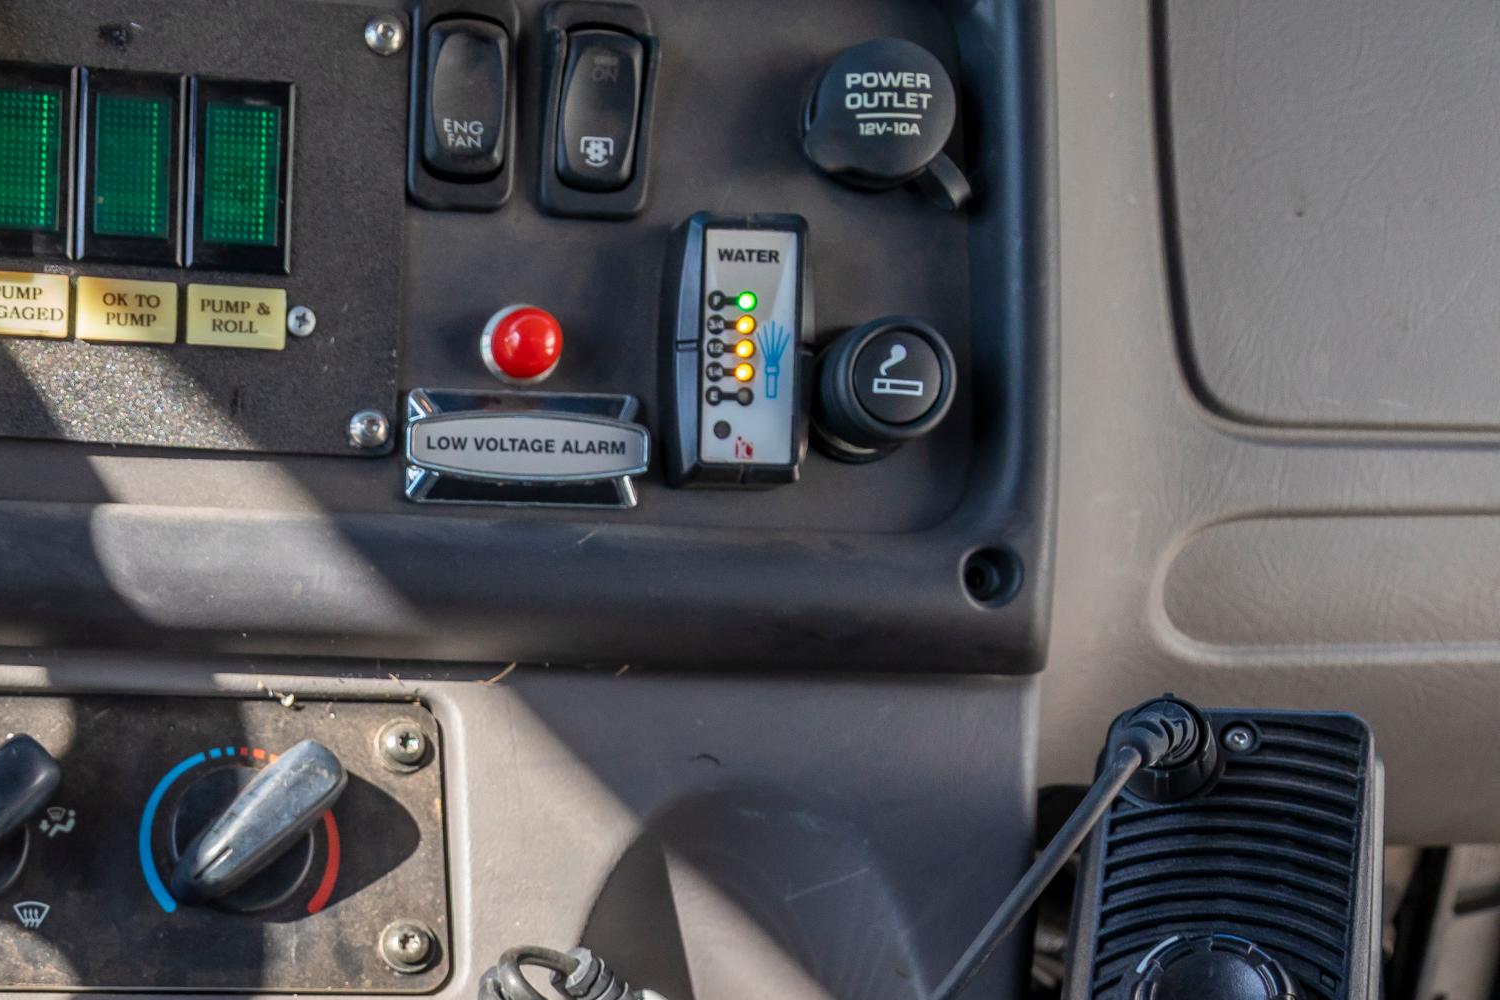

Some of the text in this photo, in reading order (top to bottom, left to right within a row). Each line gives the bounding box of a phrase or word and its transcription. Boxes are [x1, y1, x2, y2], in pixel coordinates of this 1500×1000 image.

[845, 72, 932, 89] POWER
[845, 92, 933, 110] OUTLET
[443, 118, 485, 133] ENG
[859, 122, 921, 136] 12V-10A
[447, 134, 483, 149] FAN
[718, 248, 780, 263] WATER
[102, 292, 161, 309] OK TO
[200, 298, 271, 316] PUMP &
[106, 311, 157, 328] PUMP
[211, 318, 259, 335] ROLL
[426, 436, 627, 456] LOW VOLTAGE ALARM
